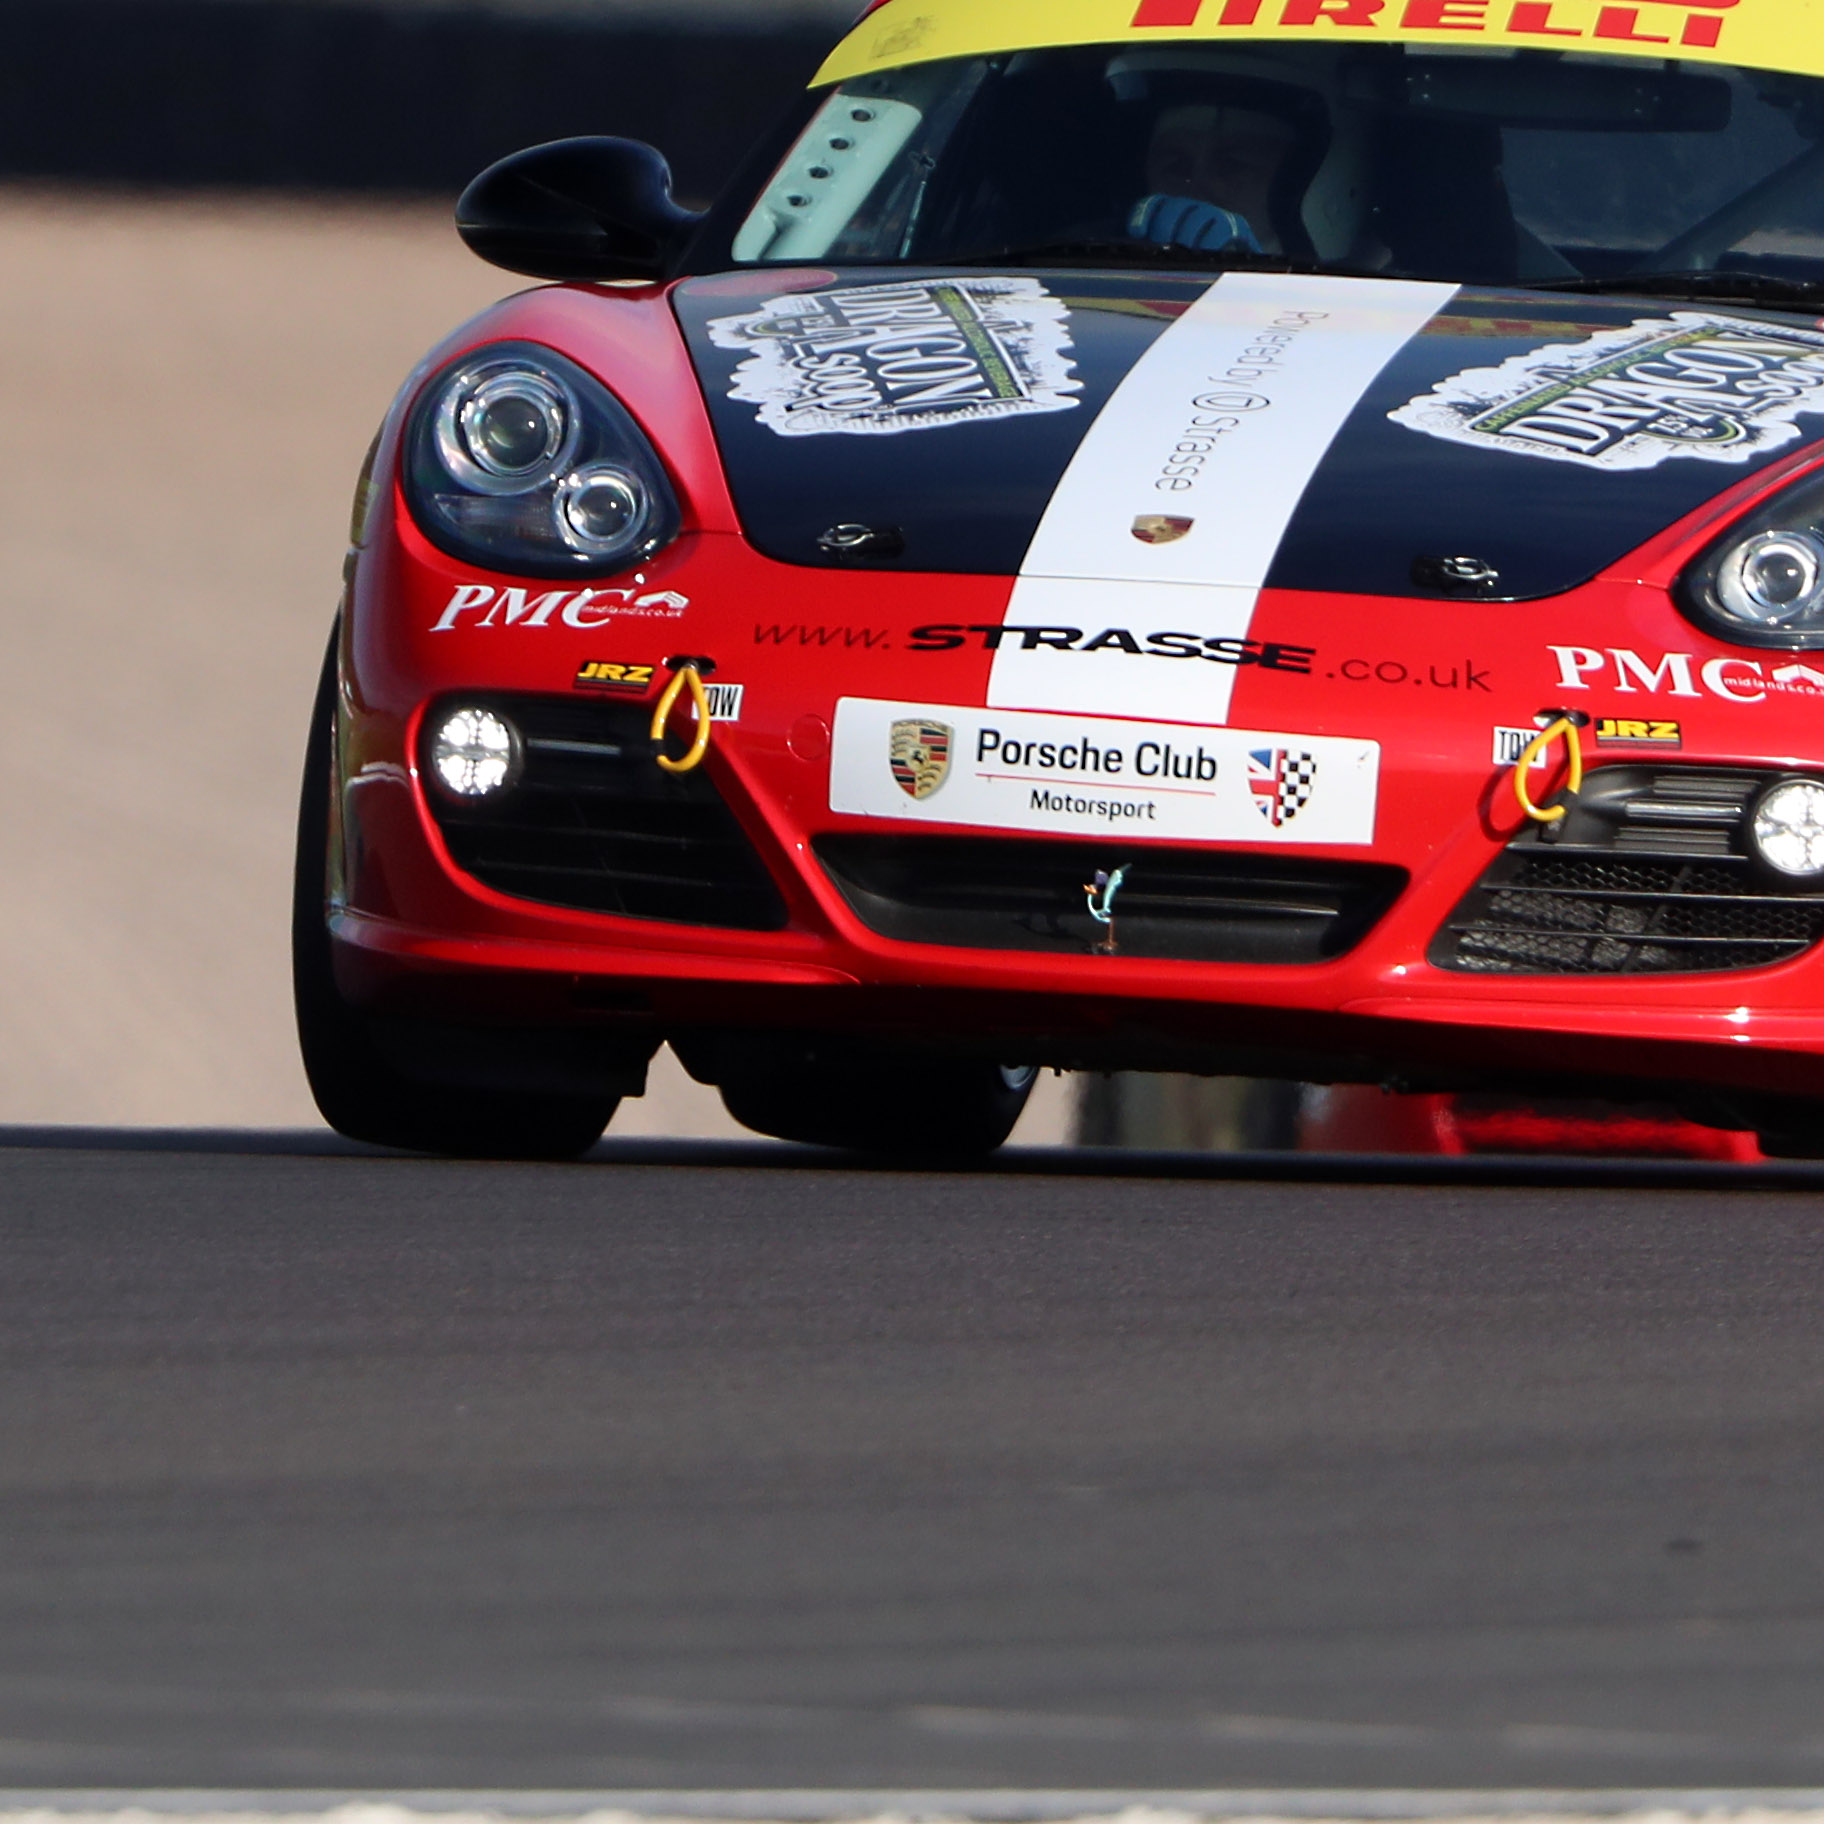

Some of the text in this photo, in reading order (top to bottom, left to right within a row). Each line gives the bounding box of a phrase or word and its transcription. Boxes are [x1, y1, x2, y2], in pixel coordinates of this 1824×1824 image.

[803, 287, 994, 406] DRAGON
[1155, 311, 1330, 491] Powered by Strasse
[1499, 331, 1788, 454] DRAGON
[428, 585, 636, 632] PMC
[577, 662, 655, 682] JRZ
[1546, 645, 1767, 702] PMC
[703, 686, 739, 716] OW
[1597, 719, 1679, 738] JRZ
[976, 728, 1218, 782] Porsche Club
[1029, 789, 1157, 823] Motorsport
